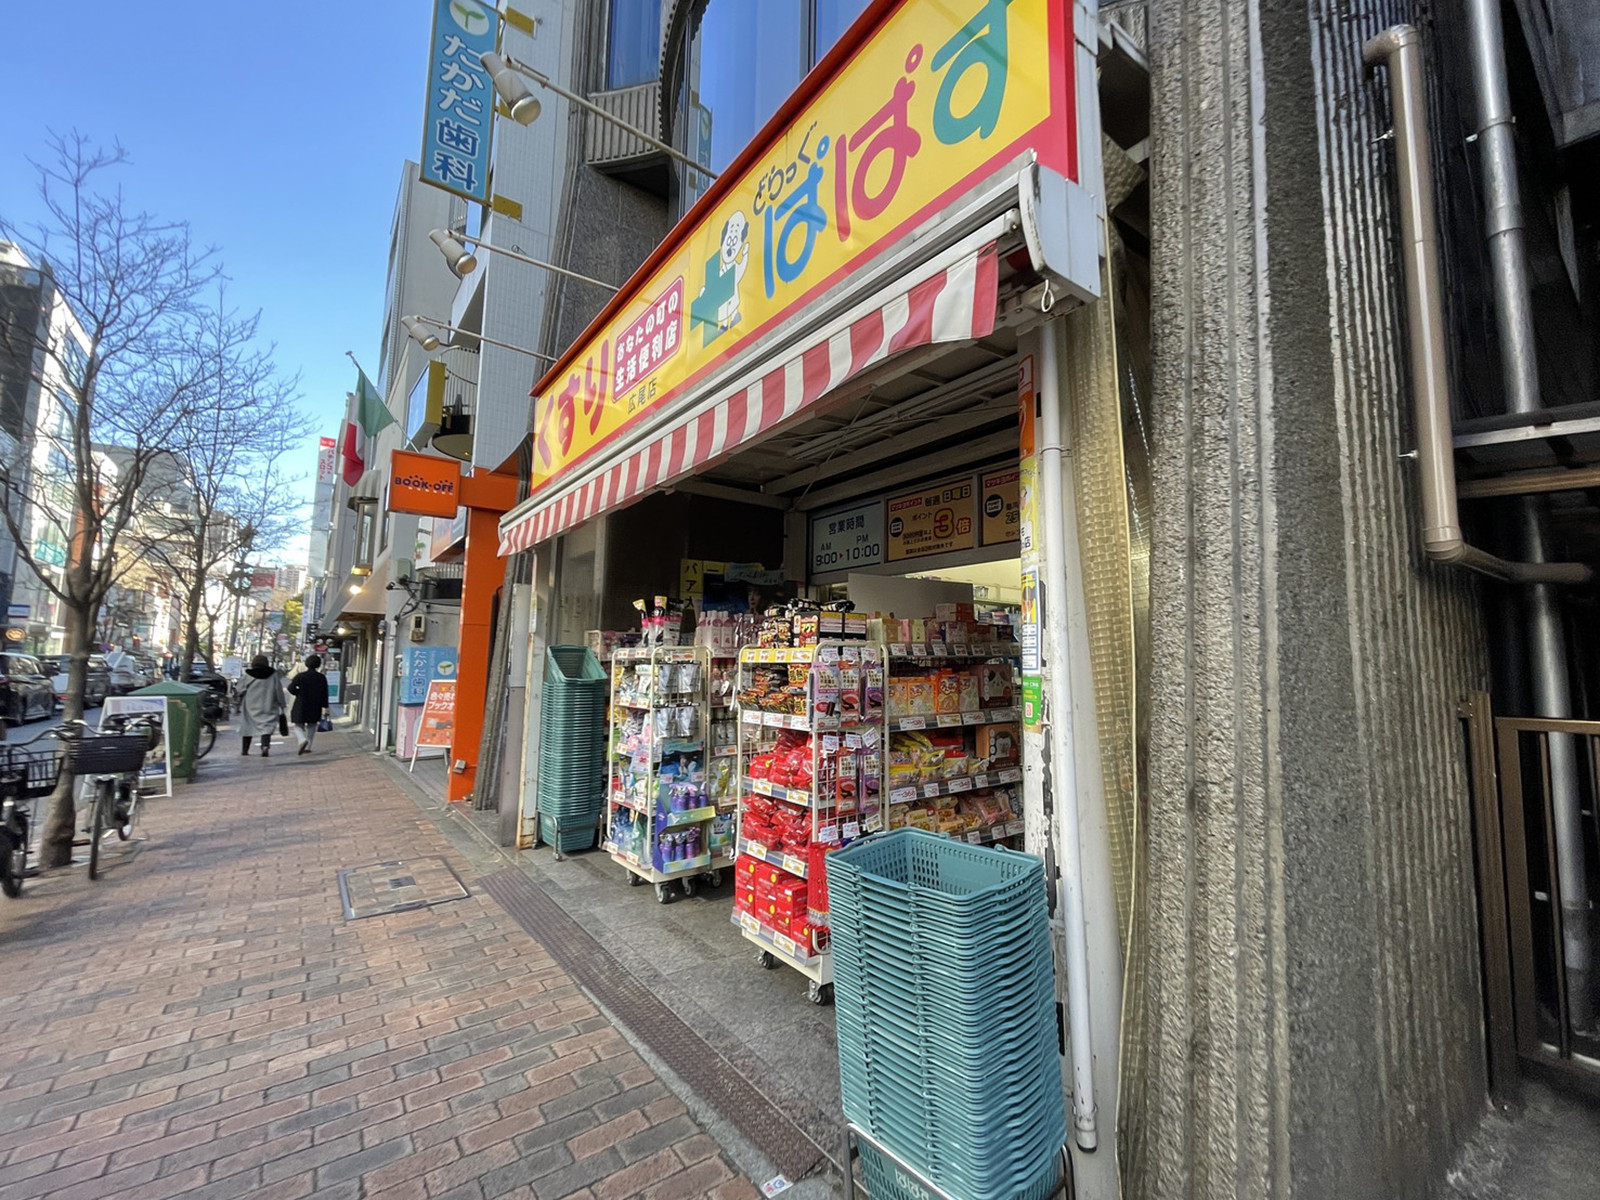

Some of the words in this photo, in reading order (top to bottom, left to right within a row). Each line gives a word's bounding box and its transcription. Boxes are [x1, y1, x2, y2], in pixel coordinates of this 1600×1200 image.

[432, 33, 483, 192] たかだ歯科
[765, 0, 1011, 298] ぱぱす
[537, 339, 609, 470] くすり
[627, 378, 657, 414] 広尾店
[828, 515, 865, 535] 営業時間
[934, 507, 955, 539] 3
[956, 517, 971, 535] 倍
[821, 542, 832, 551] AM
[856, 534, 869, 543] PM
[845, 543, 880, 561] 10:00
